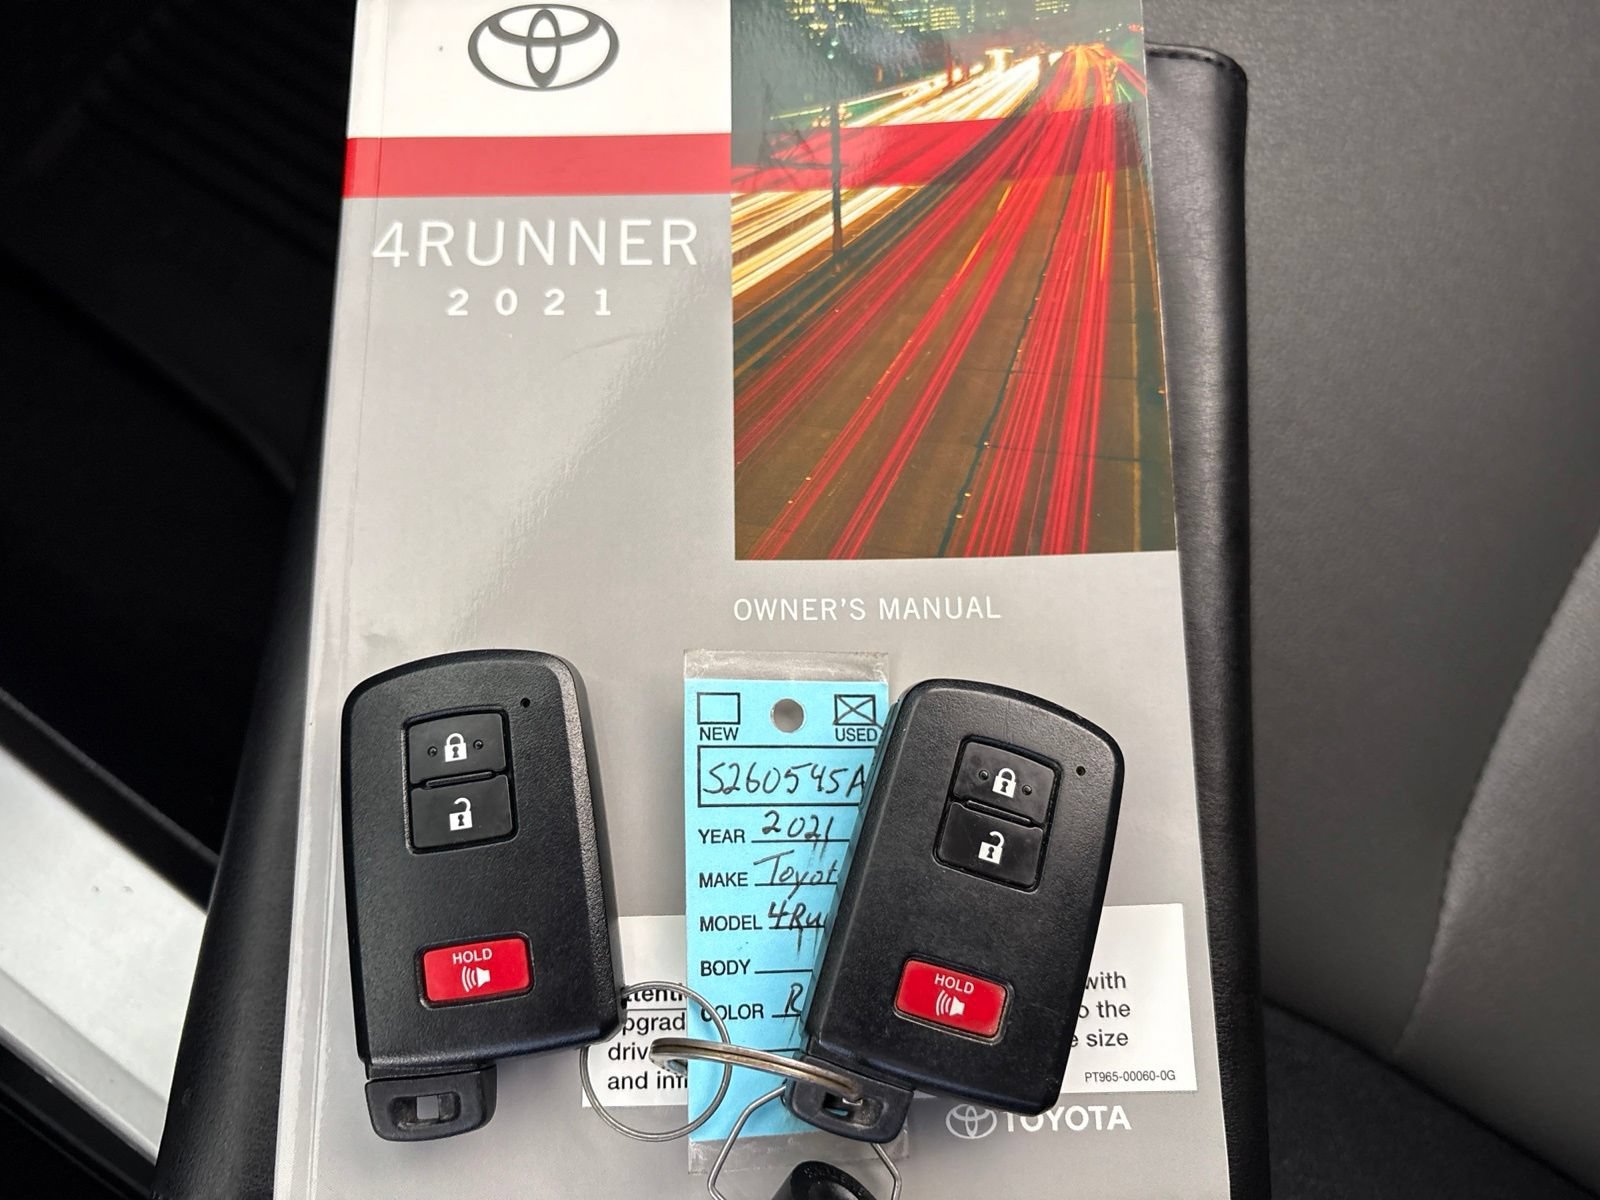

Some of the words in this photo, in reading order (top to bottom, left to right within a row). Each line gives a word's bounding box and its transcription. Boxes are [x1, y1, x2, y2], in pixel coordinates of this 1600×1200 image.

[371, 217, 699, 268] 4RUNNER
[447, 288, 612, 317] 2021
[733, 597, 866, 621] OWNER'S
[878, 596, 1003, 620] MANUAL
[699, 726, 739, 741] NEW
[834, 727, 878, 742] USED
[761, 809, 835, 842] 2021
[698, 829, 746, 844] YEAR
[699, 872, 749, 888] MAKE
[699, 915, 763, 932] MODEL
[767, 899, 829, 931] 4Ru
[451, 946, 494, 965] HOLD
[699, 958, 751, 977] BODY
[934, 972, 976, 996] HOLD
[700, 1003, 765, 1023] COLOR
[1095, 999, 1132, 1019] the
[1085, 1028, 1129, 1048] size
[607, 1071, 649, 1090] and
[1005, 1105, 1133, 1133] TOYOTA
